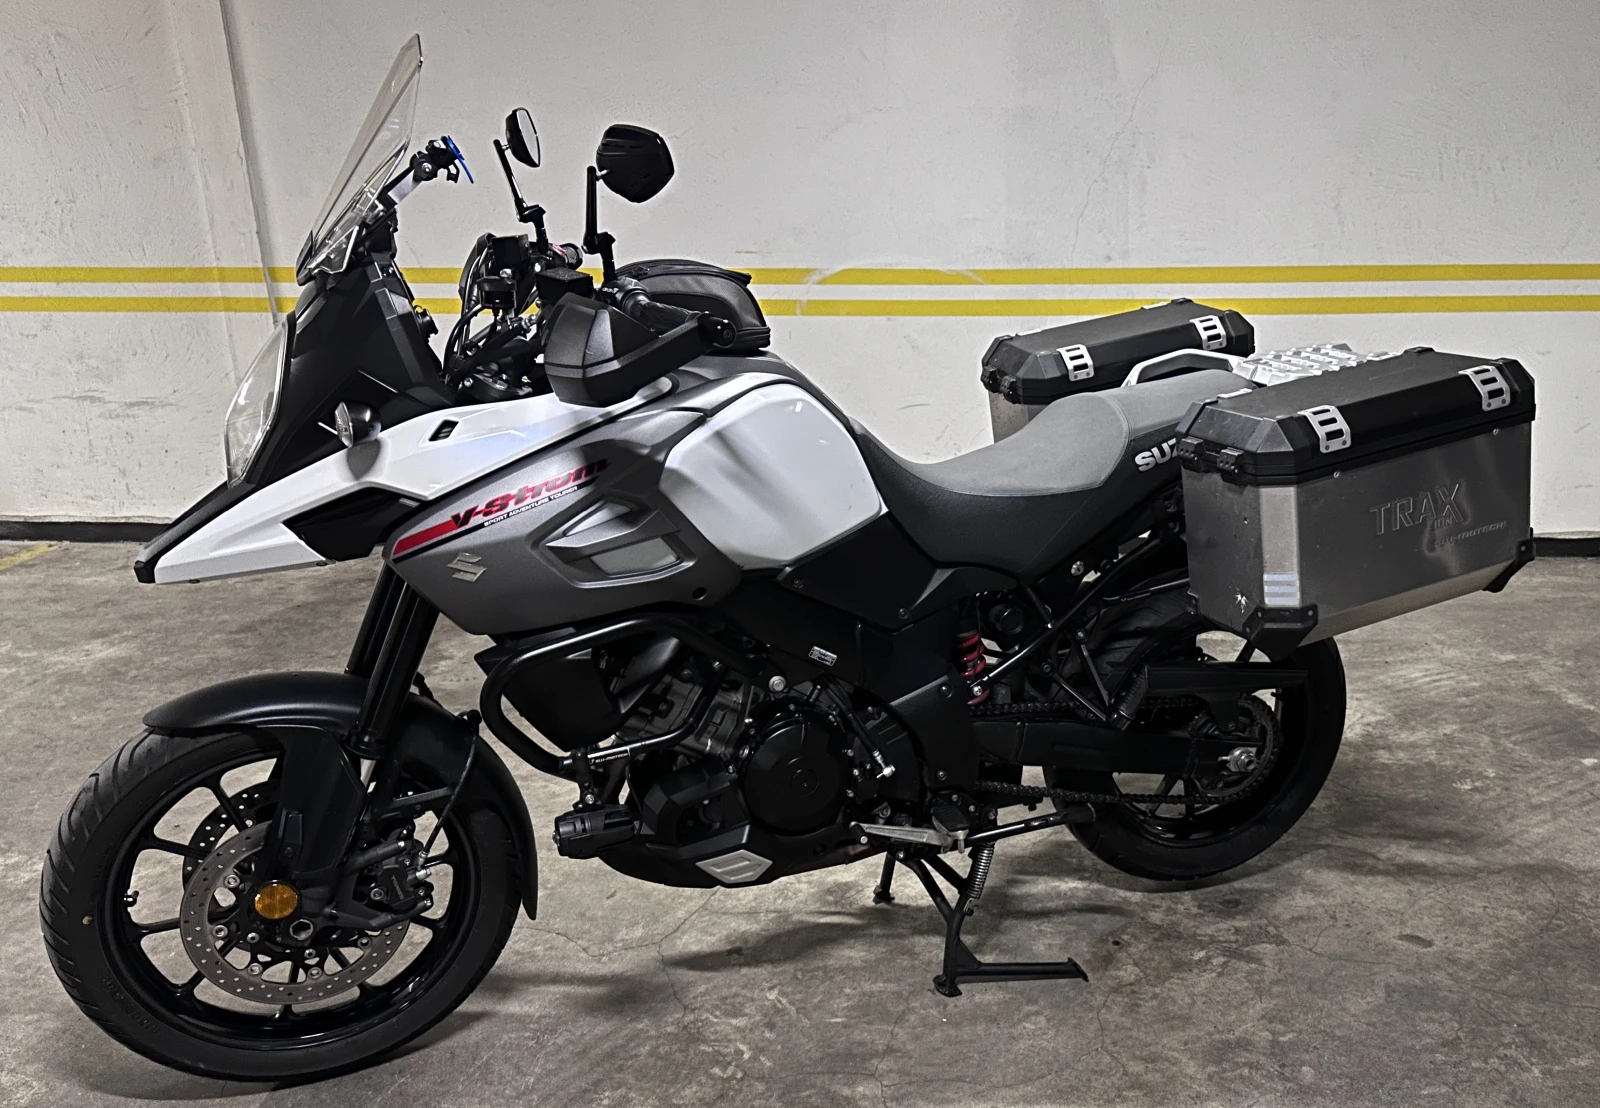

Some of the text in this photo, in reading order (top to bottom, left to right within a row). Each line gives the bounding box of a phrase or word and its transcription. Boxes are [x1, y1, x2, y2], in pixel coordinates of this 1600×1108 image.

[483, 485, 578, 527] SPORT ADVENTURE TOURER
[1369, 483, 1464, 536] TRAX
